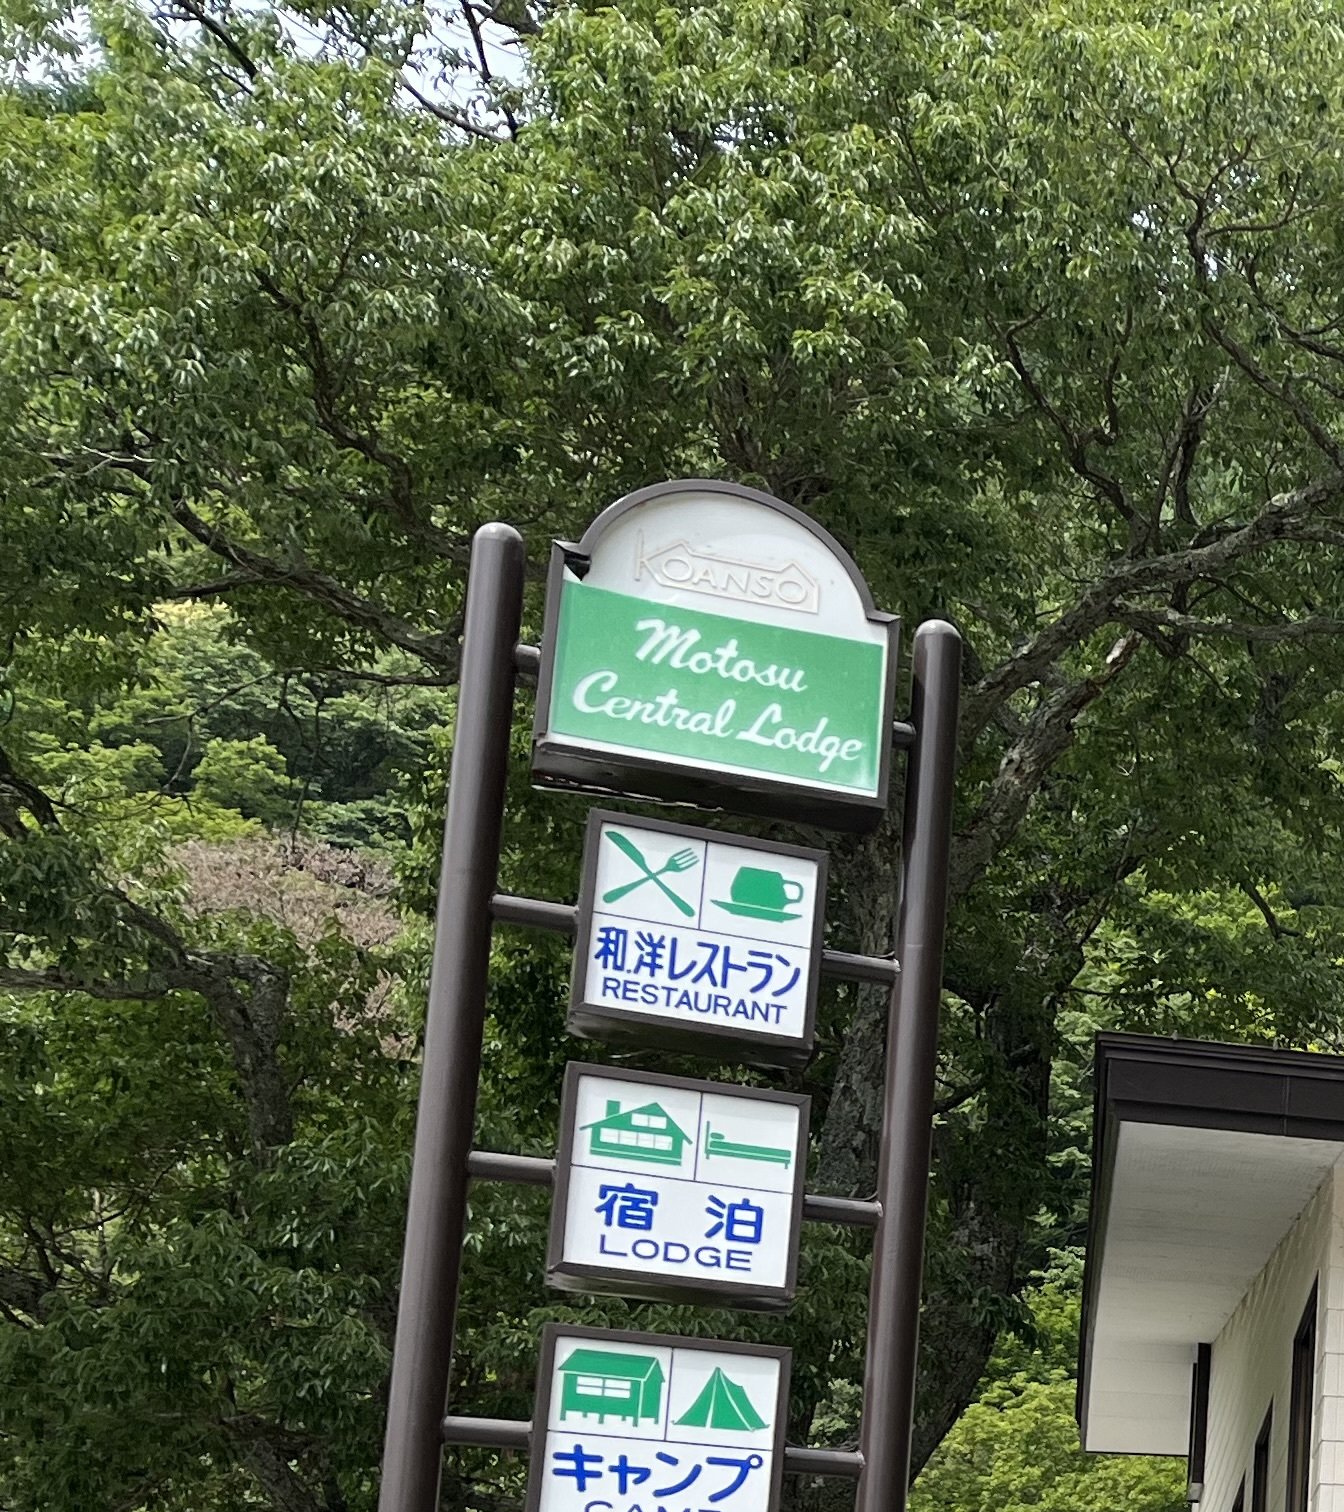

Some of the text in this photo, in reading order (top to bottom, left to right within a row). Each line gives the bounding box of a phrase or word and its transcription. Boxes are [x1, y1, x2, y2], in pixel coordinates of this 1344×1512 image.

[634, 618, 808, 693] Motosu
[572, 670, 863, 773] Central Lodge
[602, 977, 788, 1024] RESTAURANT
[599, 1234, 753, 1272] LODGE
[552, 1444, 763, 1503] キャンプ
